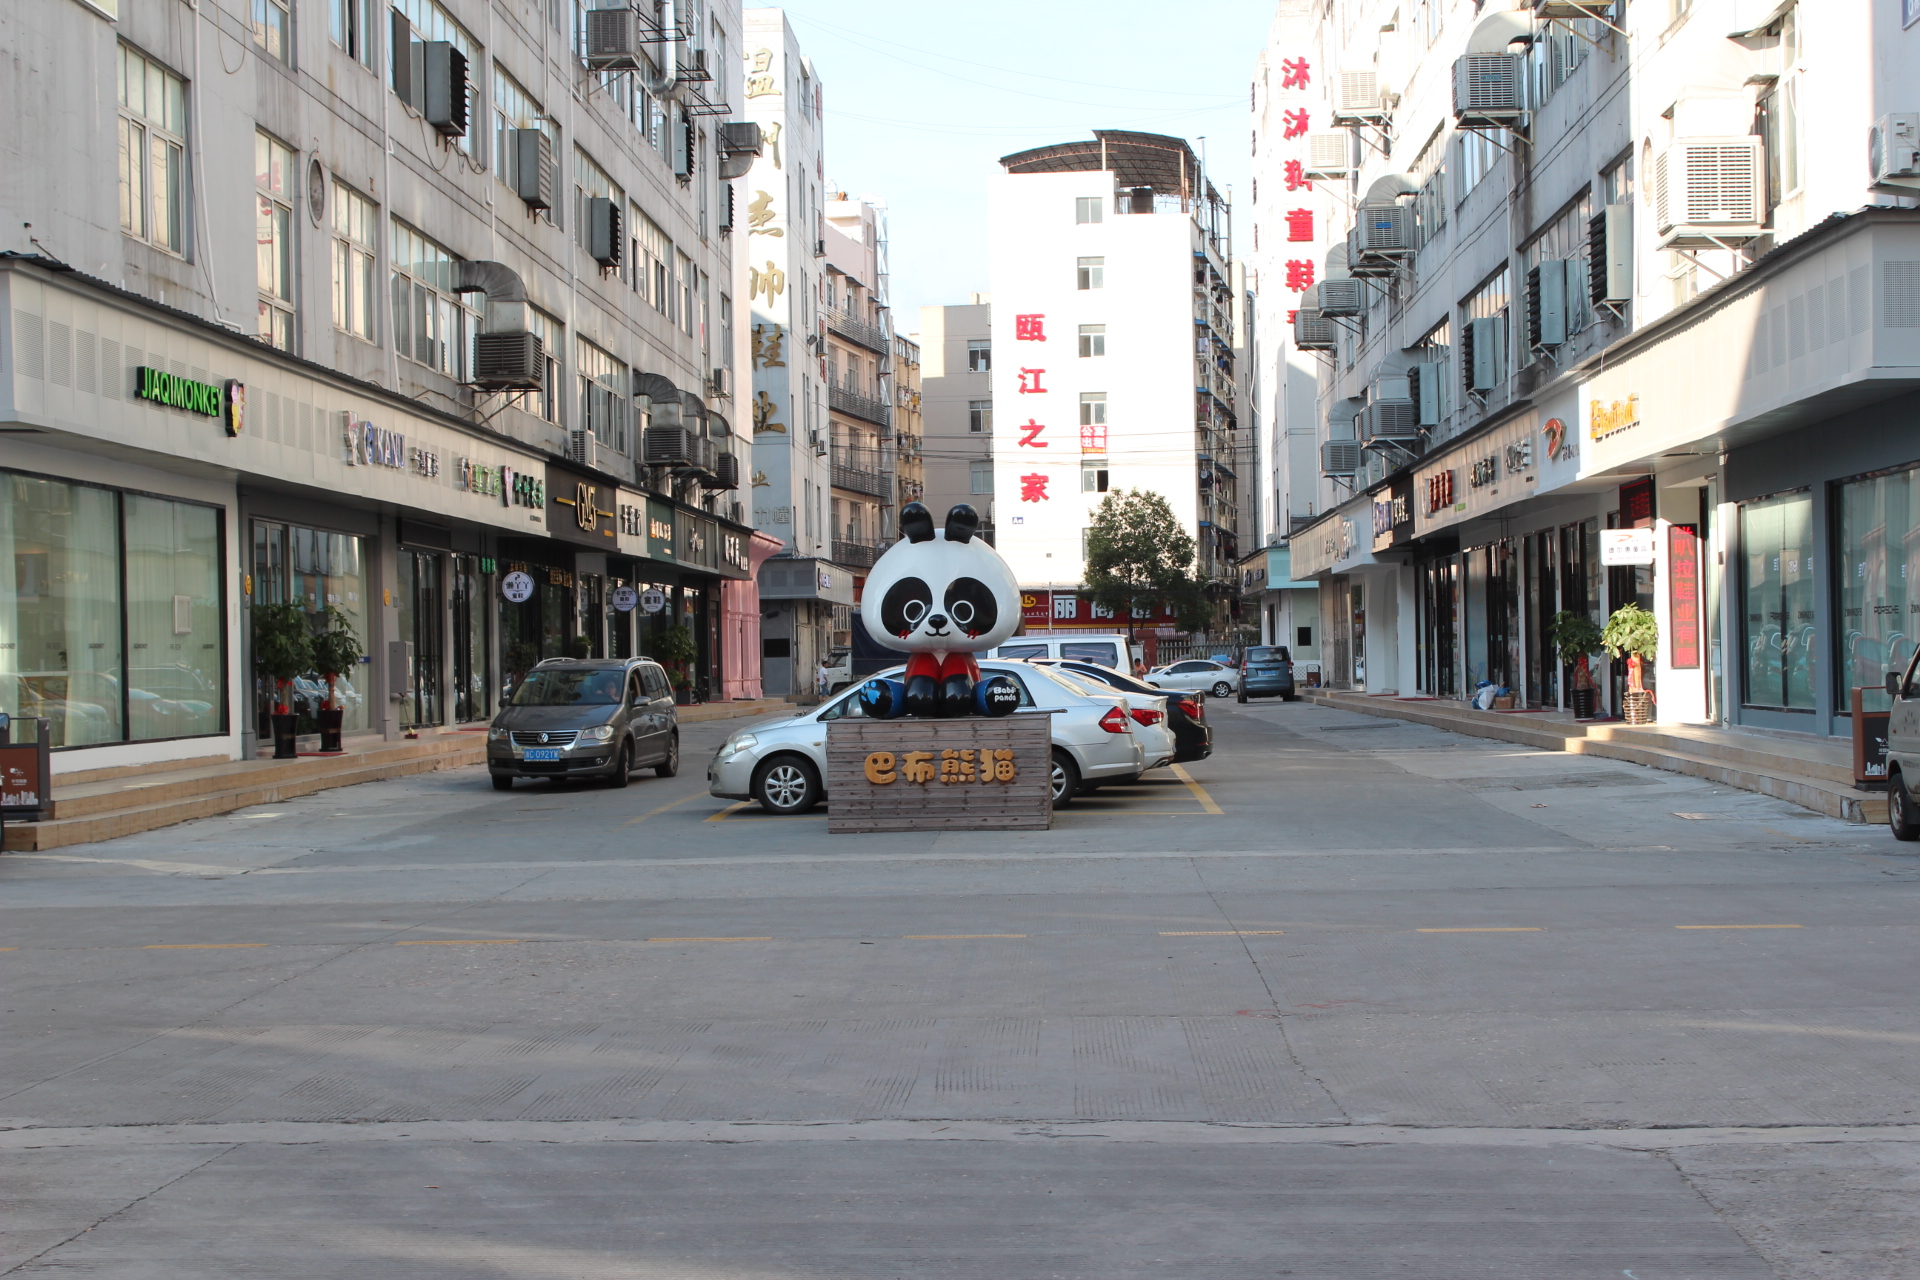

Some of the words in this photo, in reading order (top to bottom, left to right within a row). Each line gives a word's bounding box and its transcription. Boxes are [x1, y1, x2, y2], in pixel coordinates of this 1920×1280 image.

[141, 366, 223, 416] JIAQIMONKEY
[1015, 313, 1050, 503] 瓯江之家
[643, 595, 662, 605] 童鞋
[864, 748, 1015, 784] 巴布熊猫
